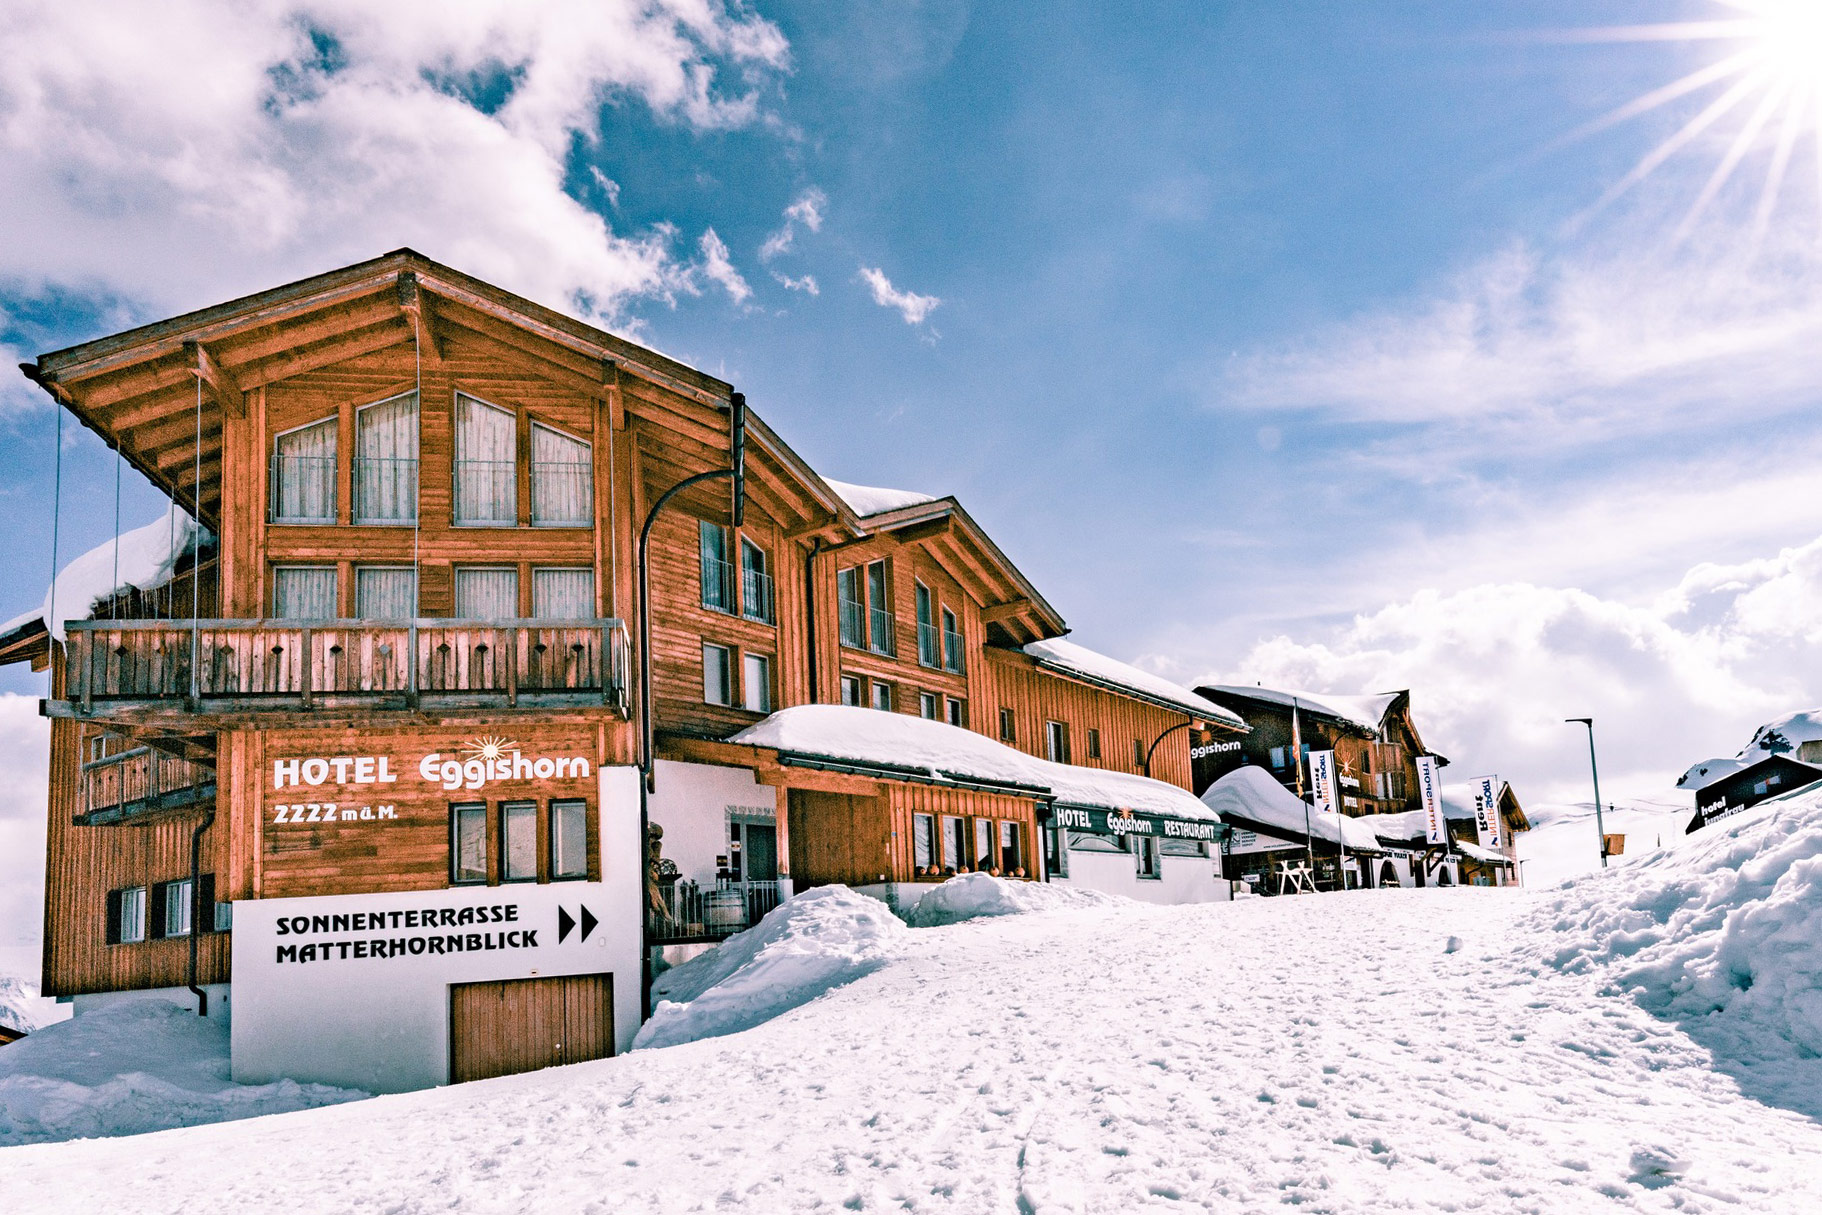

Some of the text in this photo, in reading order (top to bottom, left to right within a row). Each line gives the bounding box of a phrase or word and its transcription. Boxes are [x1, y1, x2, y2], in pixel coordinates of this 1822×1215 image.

[1190, 741, 1241, 759] ggishorn
[273, 751, 590, 790] HOTEL Eggishorn
[273, 803, 338, 823] 2222
[1701, 795, 1727, 817] hotel
[1056, 807, 1215, 840] HOTEL Eggishorn RESTAURANT
[275, 903, 519, 936] SONNENTERRASSE
[275, 929, 539, 964] MATTERHORNBLICK
